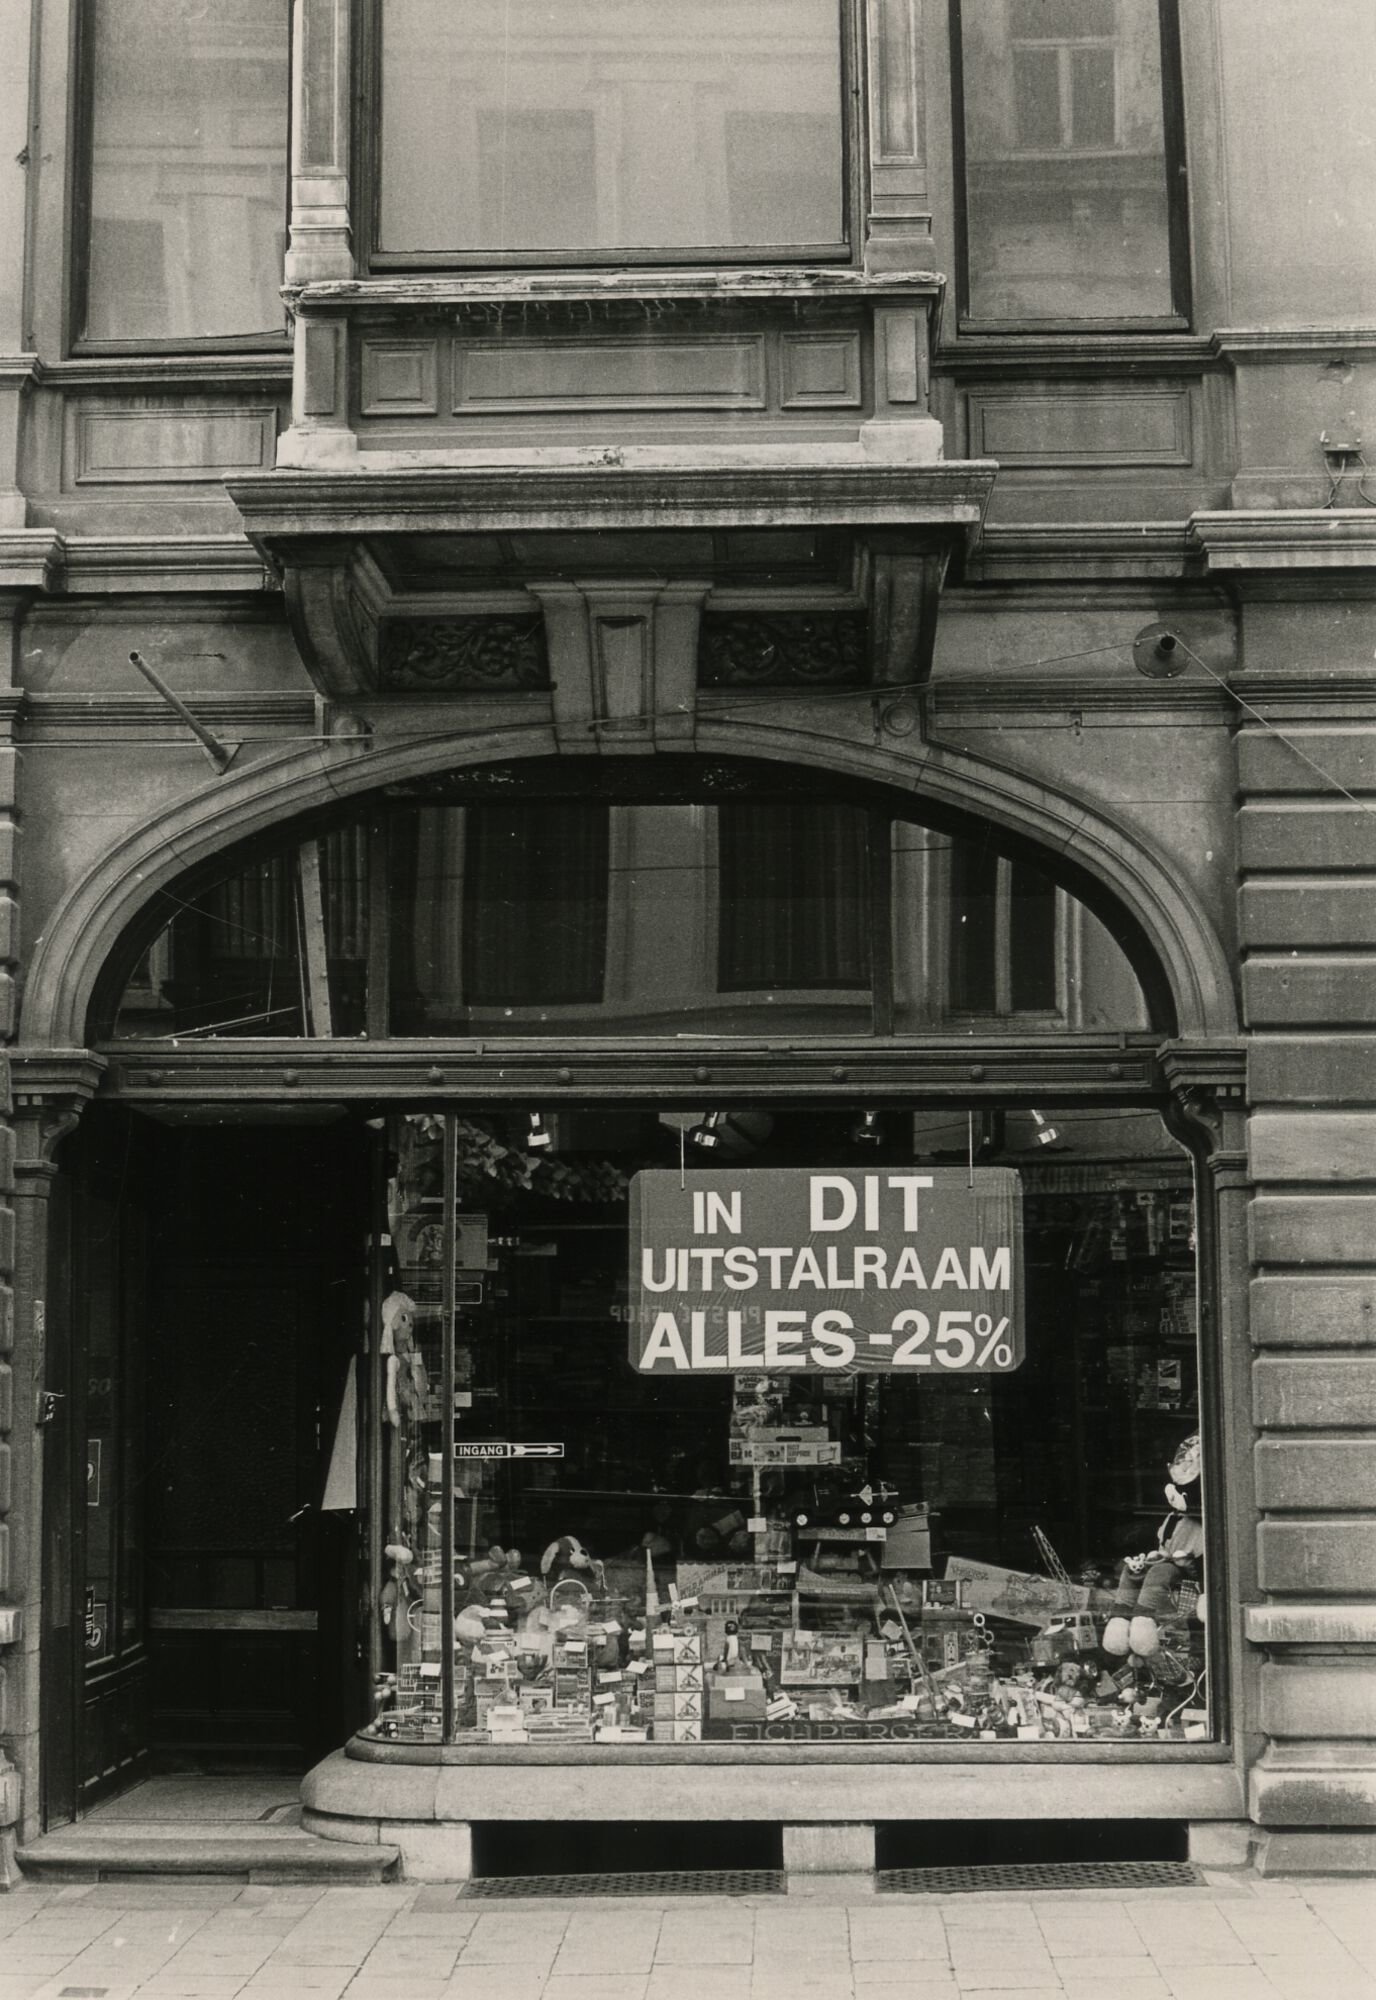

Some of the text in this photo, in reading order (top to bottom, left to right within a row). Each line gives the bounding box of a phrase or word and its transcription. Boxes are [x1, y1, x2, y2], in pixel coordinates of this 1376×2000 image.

[693, 1175, 934, 1234] IN DIT
[641, 1246, 1011, 1292] UITSTALRAAM
[638, 1308, 1013, 1369] ALLES -25%
[459, 1445, 504, 1456] INGANG
